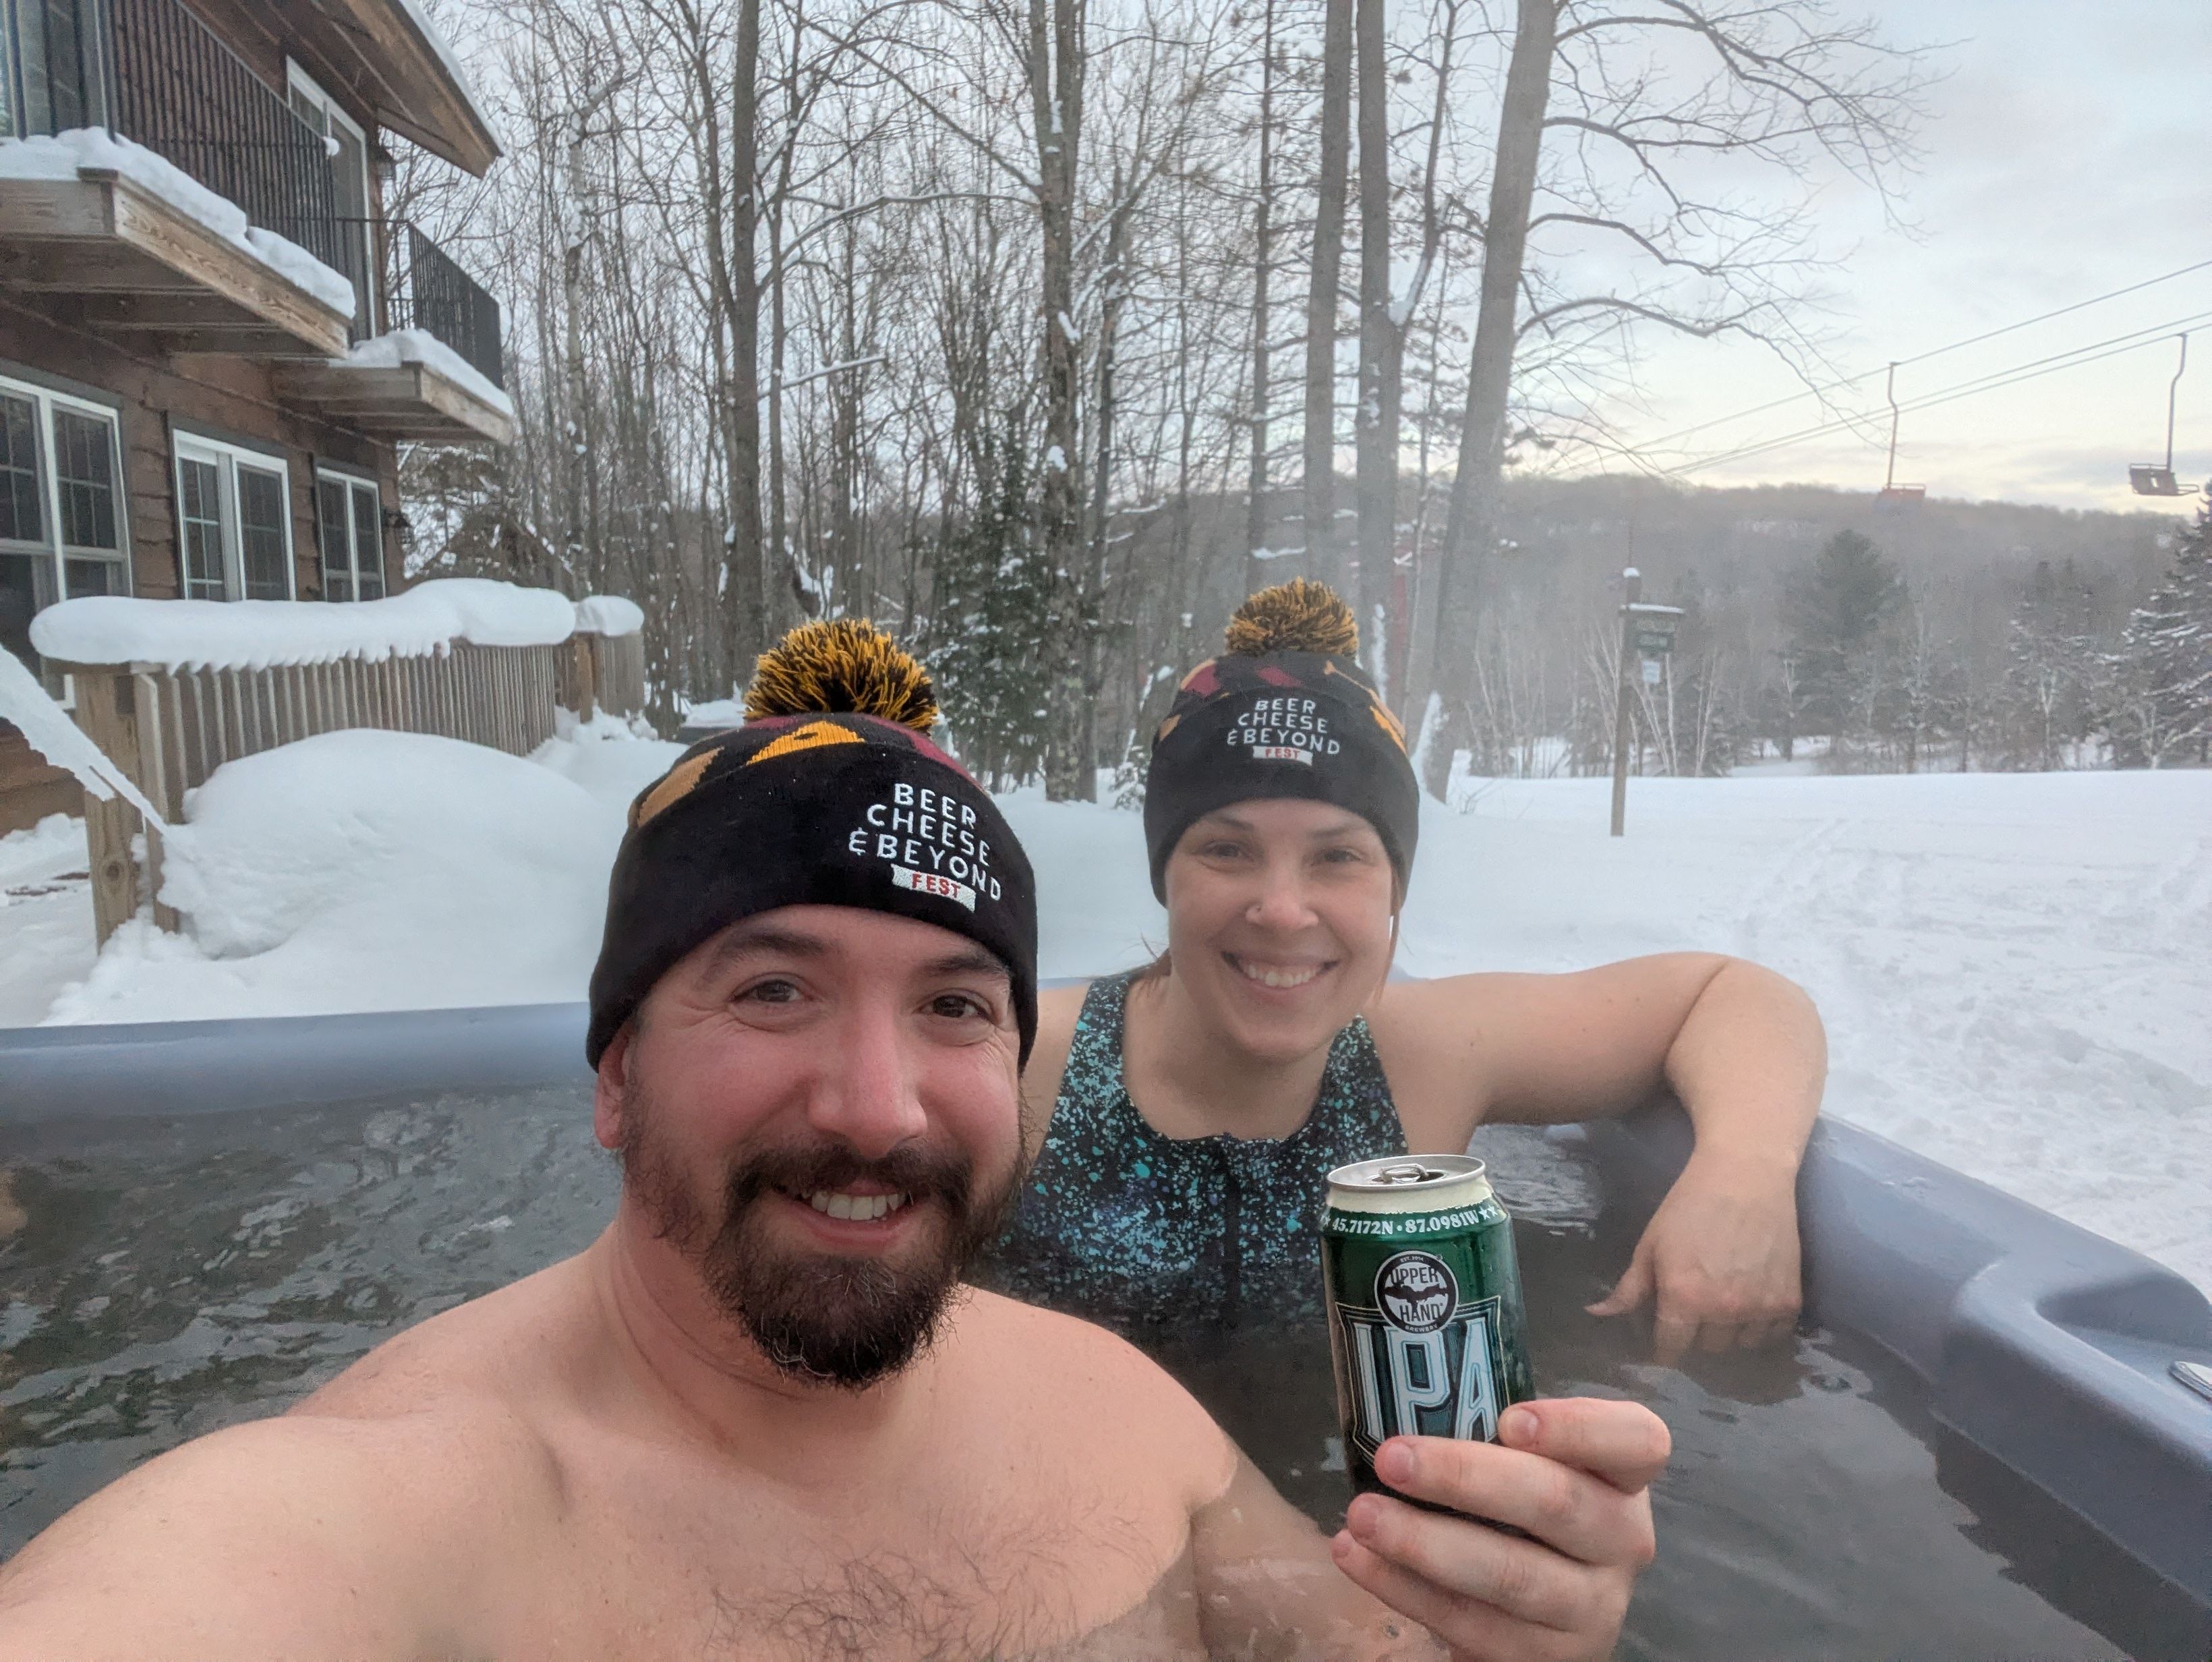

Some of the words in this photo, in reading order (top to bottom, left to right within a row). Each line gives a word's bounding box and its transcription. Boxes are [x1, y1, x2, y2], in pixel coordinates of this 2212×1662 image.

[1255, 697, 1316, 715] BEER
[1238, 712, 1328, 734] CHEESE
[1265, 748, 1300, 760] FEST
[894, 783, 977, 830] BEER
[867, 804, 991, 867] CHEESE
[911, 871, 962, 898] FEST
[1332, 1217, 1394, 1235] 45.7172N
[1405, 1209, 1480, 1233] 87.0981W
[1391, 1267, 1439, 1286] UPPER
[1399, 1304, 1440, 1322] HAND
[1405, 1323, 1438, 1333] BREWERY
[1353, 1317, 1498, 1442] IPA
